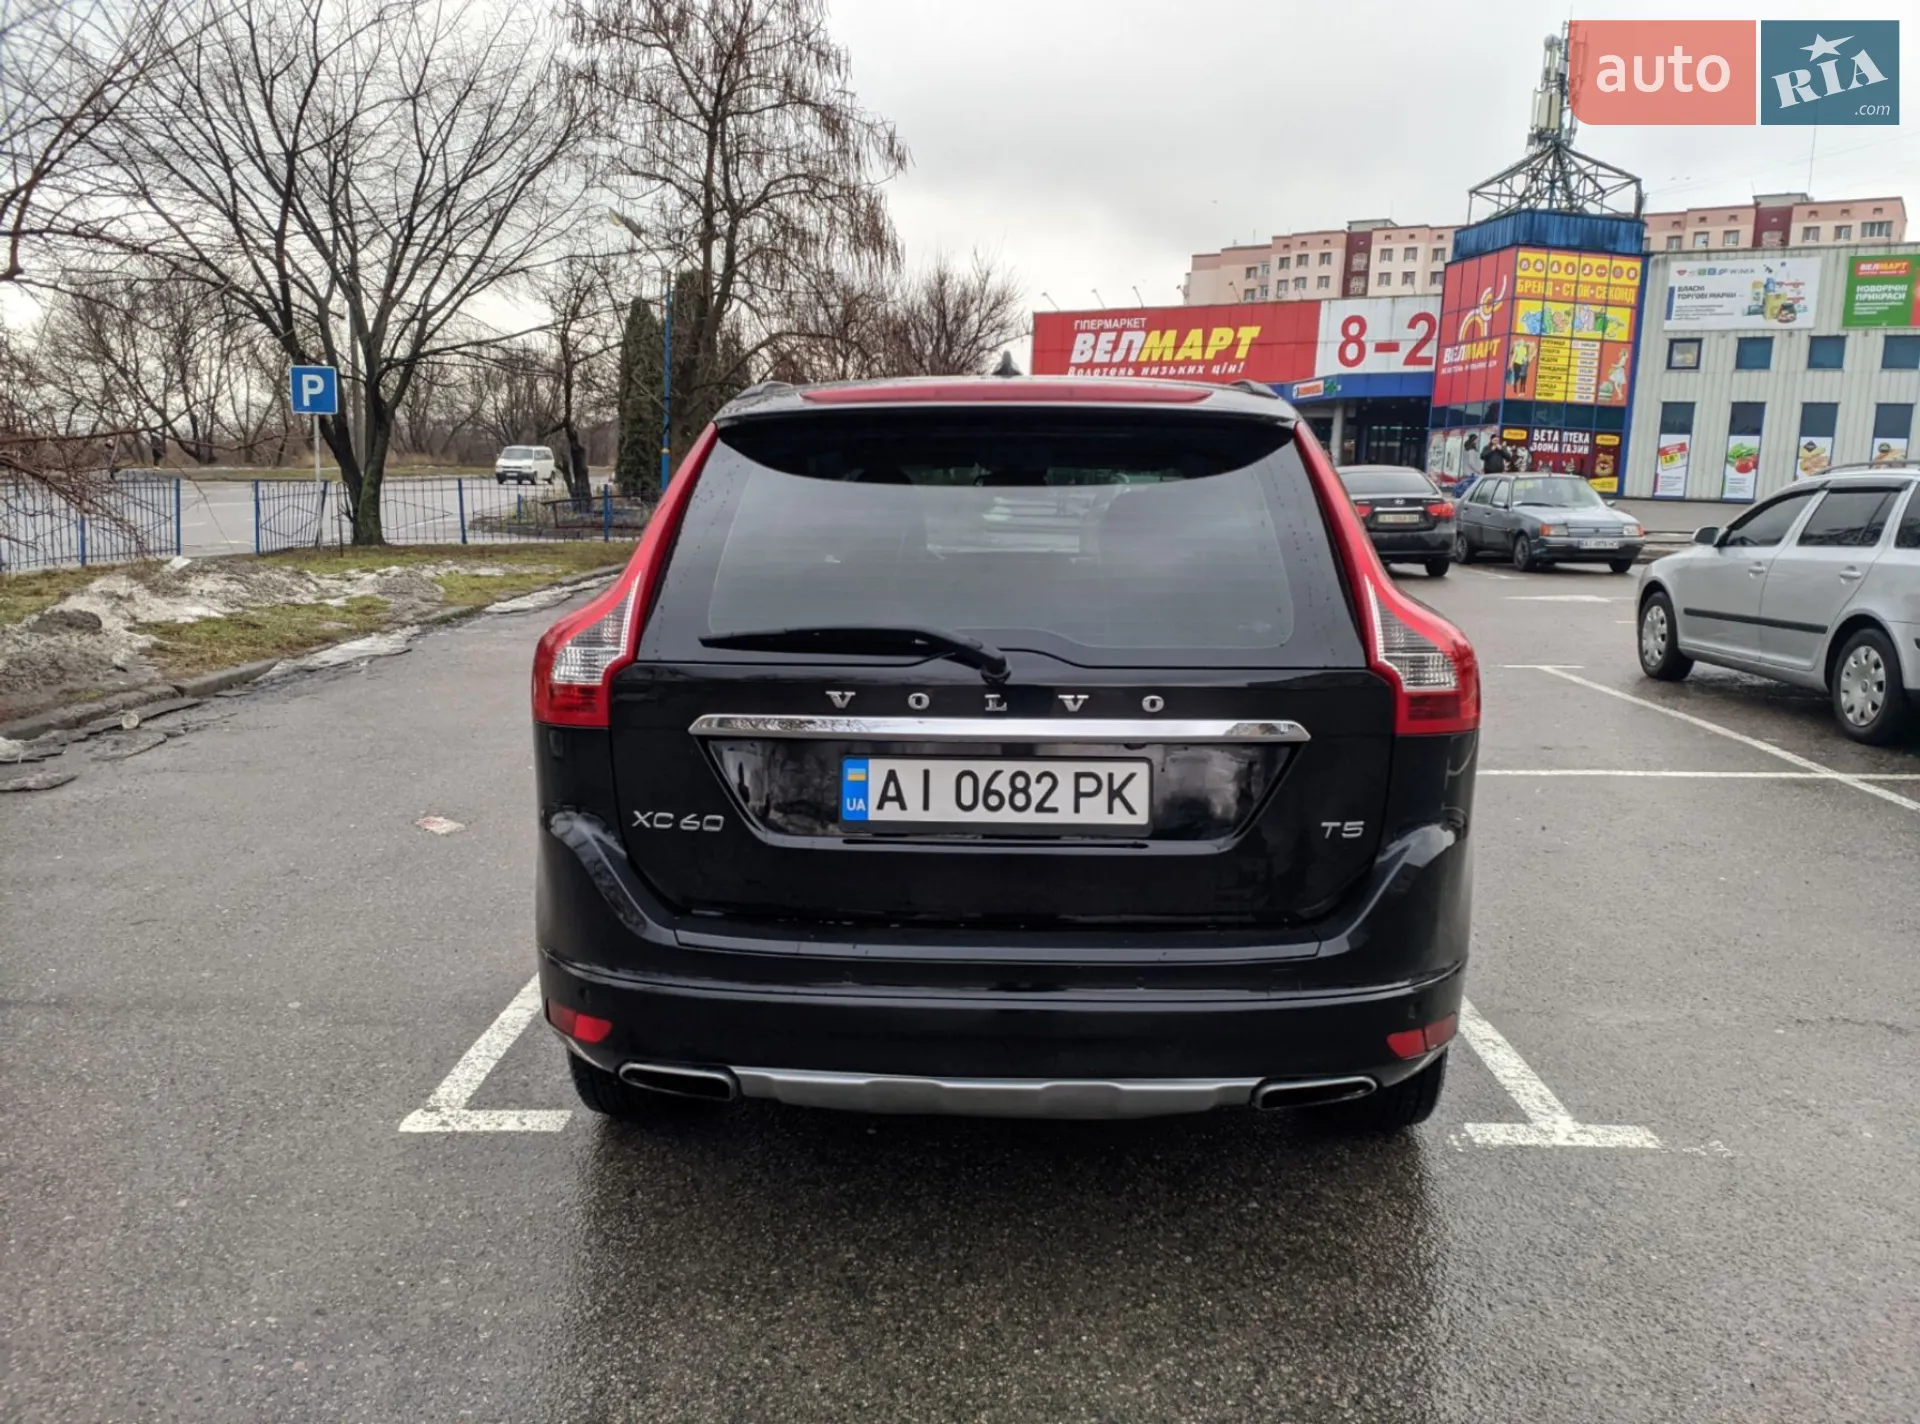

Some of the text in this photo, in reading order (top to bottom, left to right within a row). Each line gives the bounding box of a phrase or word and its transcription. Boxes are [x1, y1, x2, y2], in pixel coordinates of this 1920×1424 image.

[1517, 279, 1554, 297] БРЕНД
[1595, 285, 1636, 304] СЕКОНД
[1074, 317, 1147, 330] ГІПЕРМАРКЕТ
[1070, 326, 1261, 364] ВЕЛМАРТ
[1140, 364, 1205, 376] низьких
[1211, 362, 1246, 376] цін!
[302, 374, 325, 407] P
[825, 690, 1165, 713] VOLVO
[876, 768, 1138, 815] AI 0682 PK
[846, 798, 866, 812] UA
[1320, 820, 1364, 839] T5
